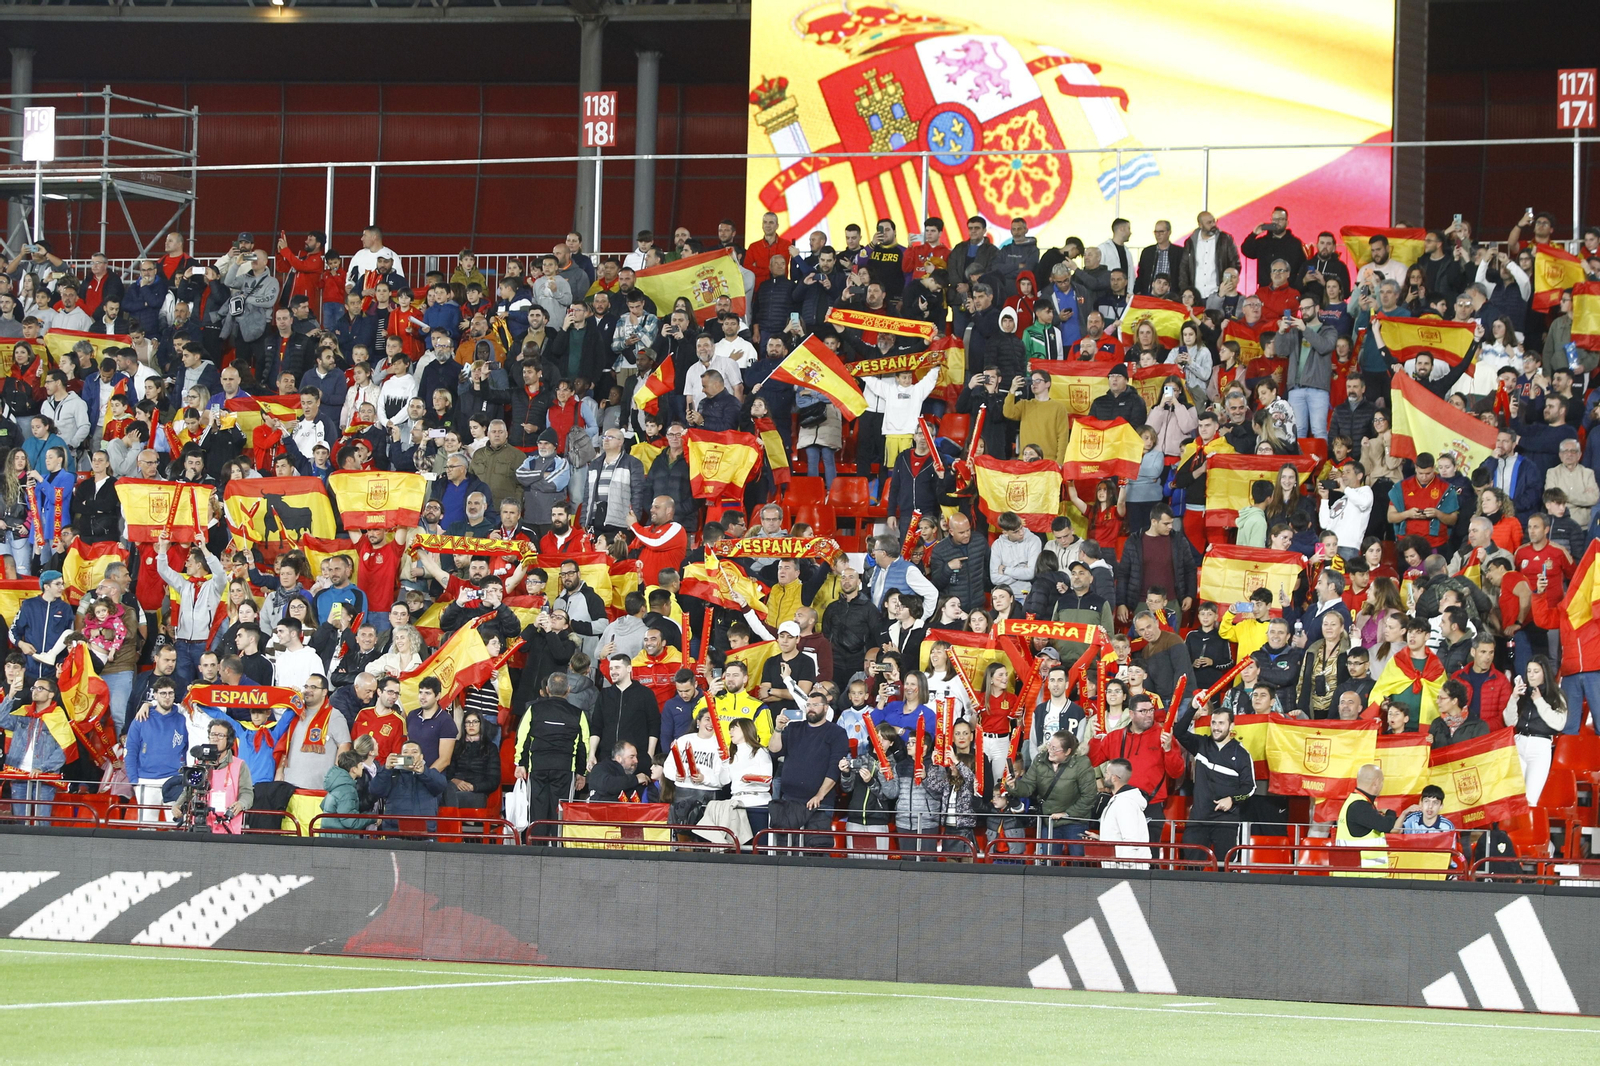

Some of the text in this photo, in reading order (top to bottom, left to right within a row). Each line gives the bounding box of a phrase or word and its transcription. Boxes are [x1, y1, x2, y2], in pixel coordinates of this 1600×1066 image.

[1559, 71, 1589, 96] 117
[584, 94, 610, 116] 118
[1559, 100, 1588, 127] 17
[25, 110, 50, 132] 119
[584, 121, 609, 146] 18
[870, 251, 899, 263] AKERS
[861, 354, 917, 372] ESPAÑA
[742, 537, 804, 553] ESPAÑA
[1011, 622, 1079, 639] ESPAÑA
[211, 689, 268, 704] ESPAÑA
